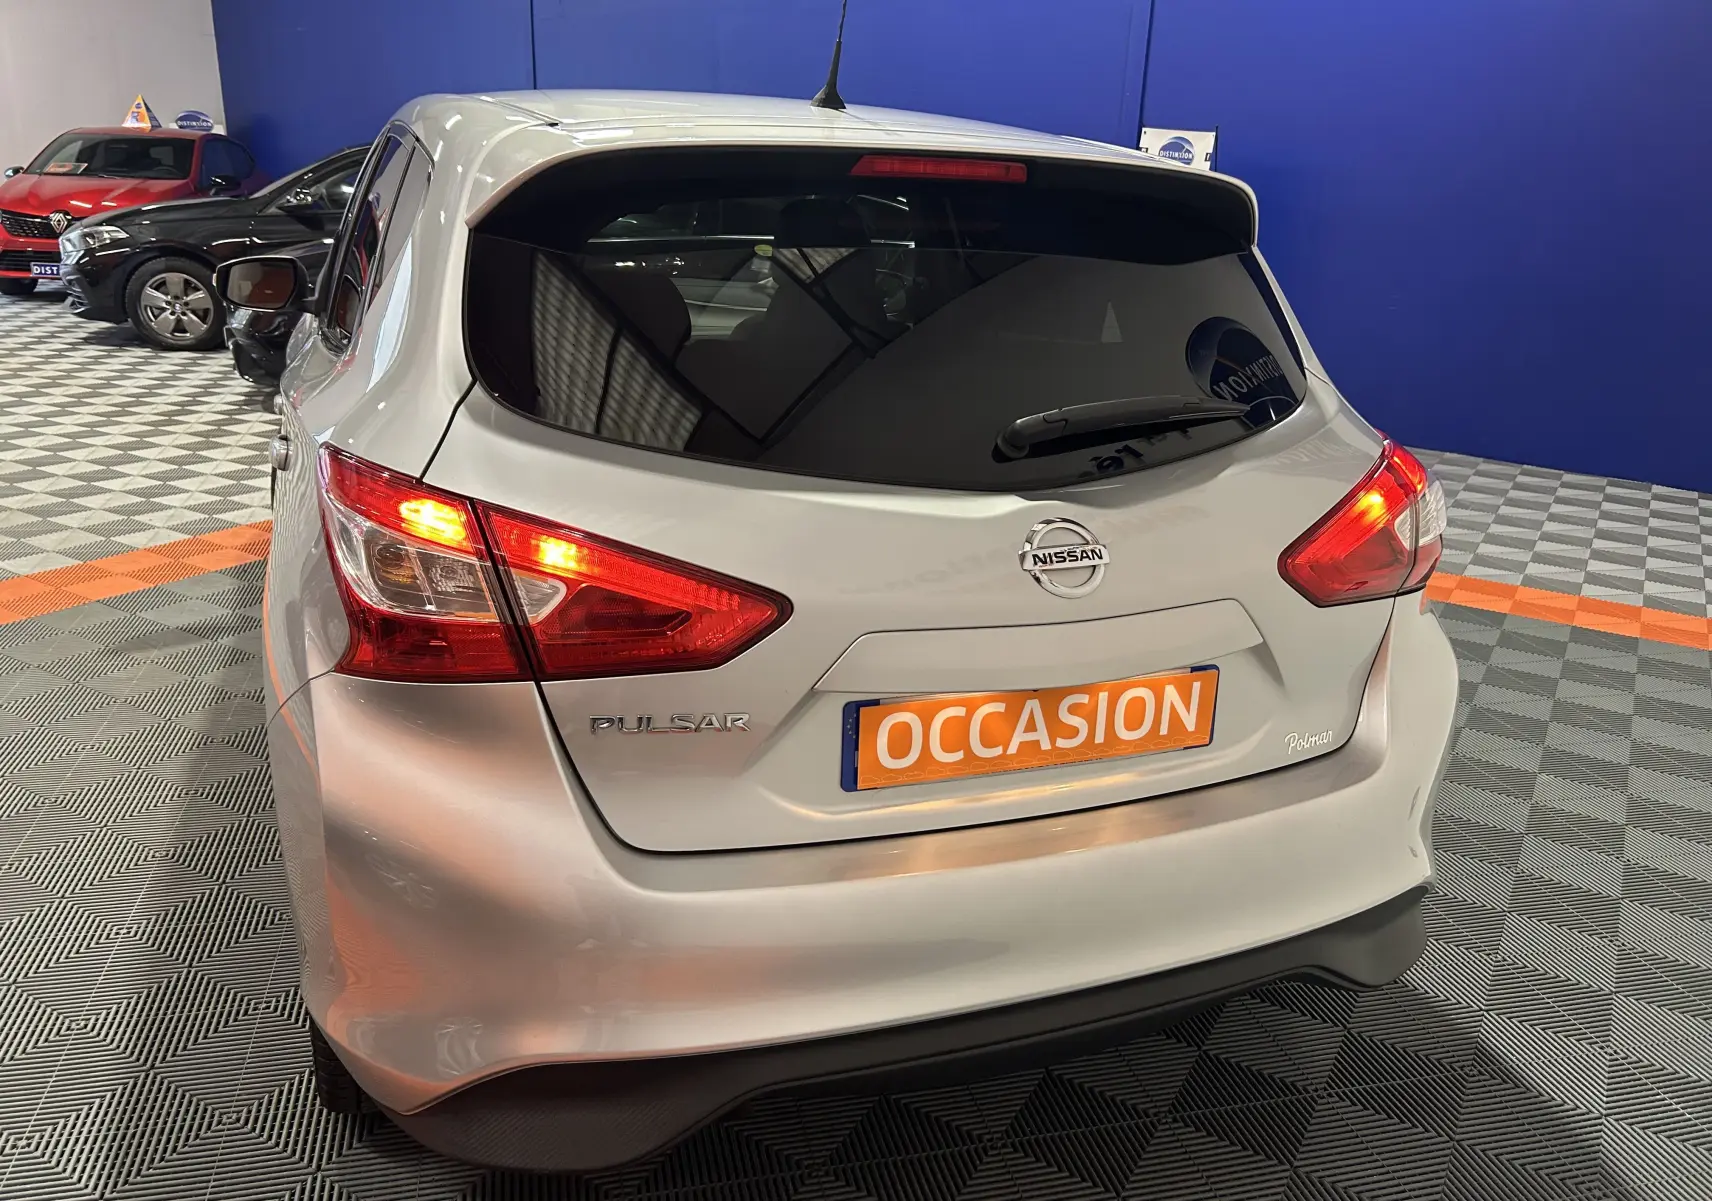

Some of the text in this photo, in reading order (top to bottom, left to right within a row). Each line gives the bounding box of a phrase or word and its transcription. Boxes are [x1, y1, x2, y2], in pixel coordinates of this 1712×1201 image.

[1031, 548, 1104, 566] NISSAN
[589, 712, 751, 735] PULSAR
[876, 681, 1201, 769] OCCASION
